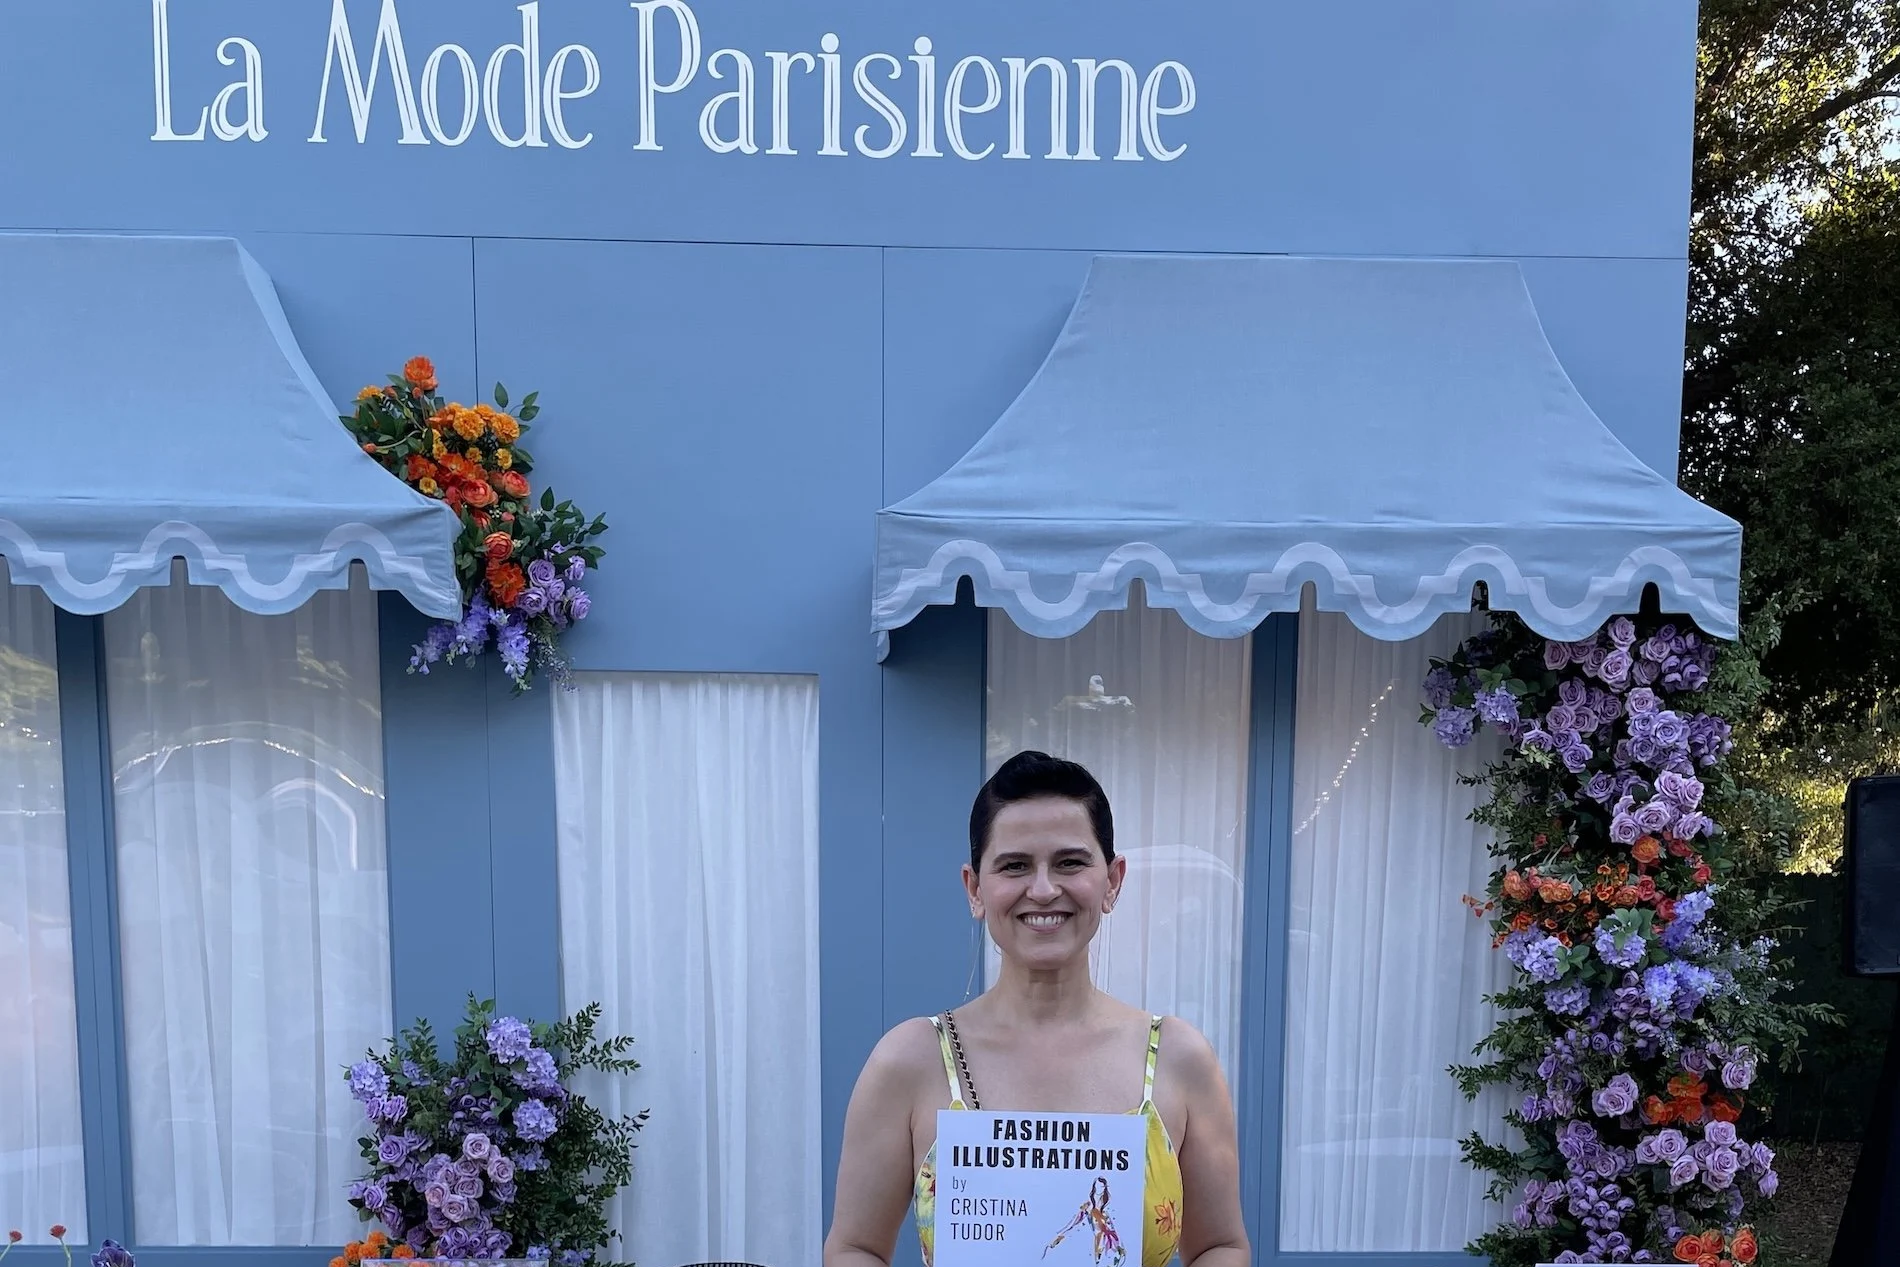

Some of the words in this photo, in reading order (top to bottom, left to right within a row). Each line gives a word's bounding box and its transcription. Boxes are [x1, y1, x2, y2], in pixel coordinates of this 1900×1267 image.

[150, 0, 269, 142] La
[307, 0, 601, 149] Mode
[630, 0, 1197, 162] Parisienne
[993, 1119, 1091, 1142] FASHION
[953, 1146, 1129, 1171] ILLUSTRATIONS
[952, 1176, 967, 1192] by
[951, 1198, 1028, 1217] CRISTINA
[950, 1223, 1005, 1241] TUDOR
